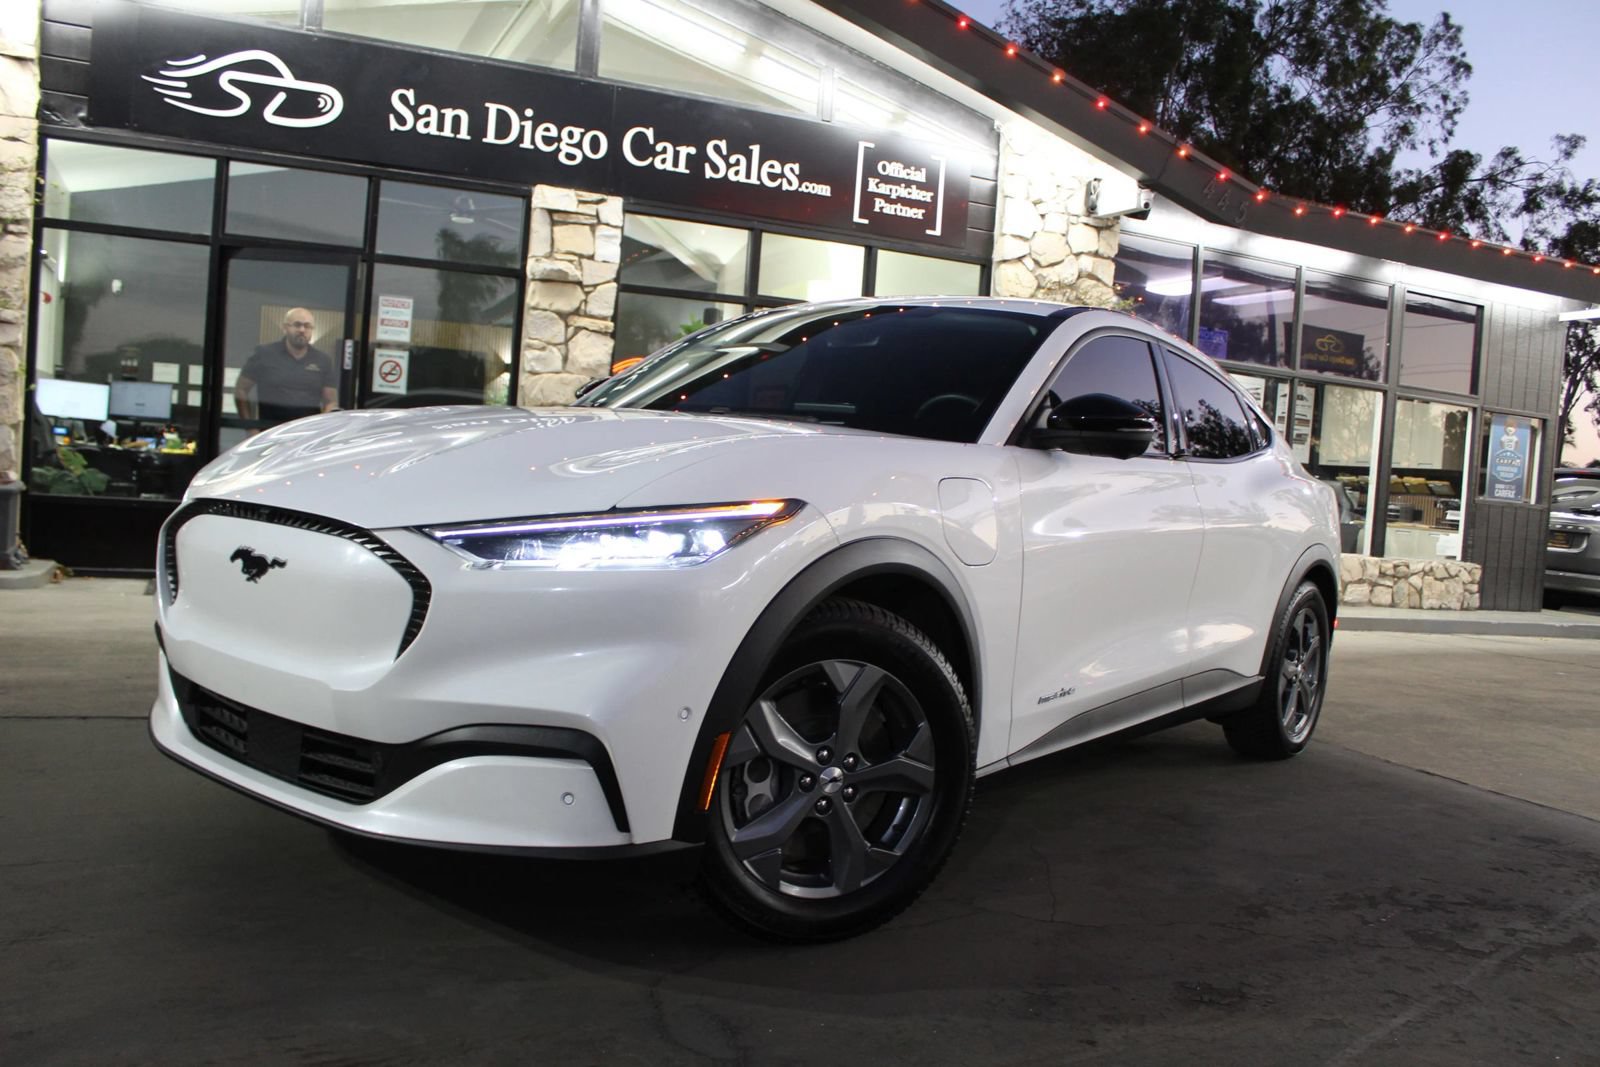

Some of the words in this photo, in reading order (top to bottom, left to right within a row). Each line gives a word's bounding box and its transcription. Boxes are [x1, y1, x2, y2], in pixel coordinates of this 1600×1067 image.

[389, 88, 472, 141] San
[482, 102, 609, 166] Diego
[622, 126, 697, 174] Car
[704, 139, 832, 197] Sales.com
[877, 160, 927, 182] Official
[867, 177, 935, 203] Karpicker
[873, 198, 926, 220] Partner
